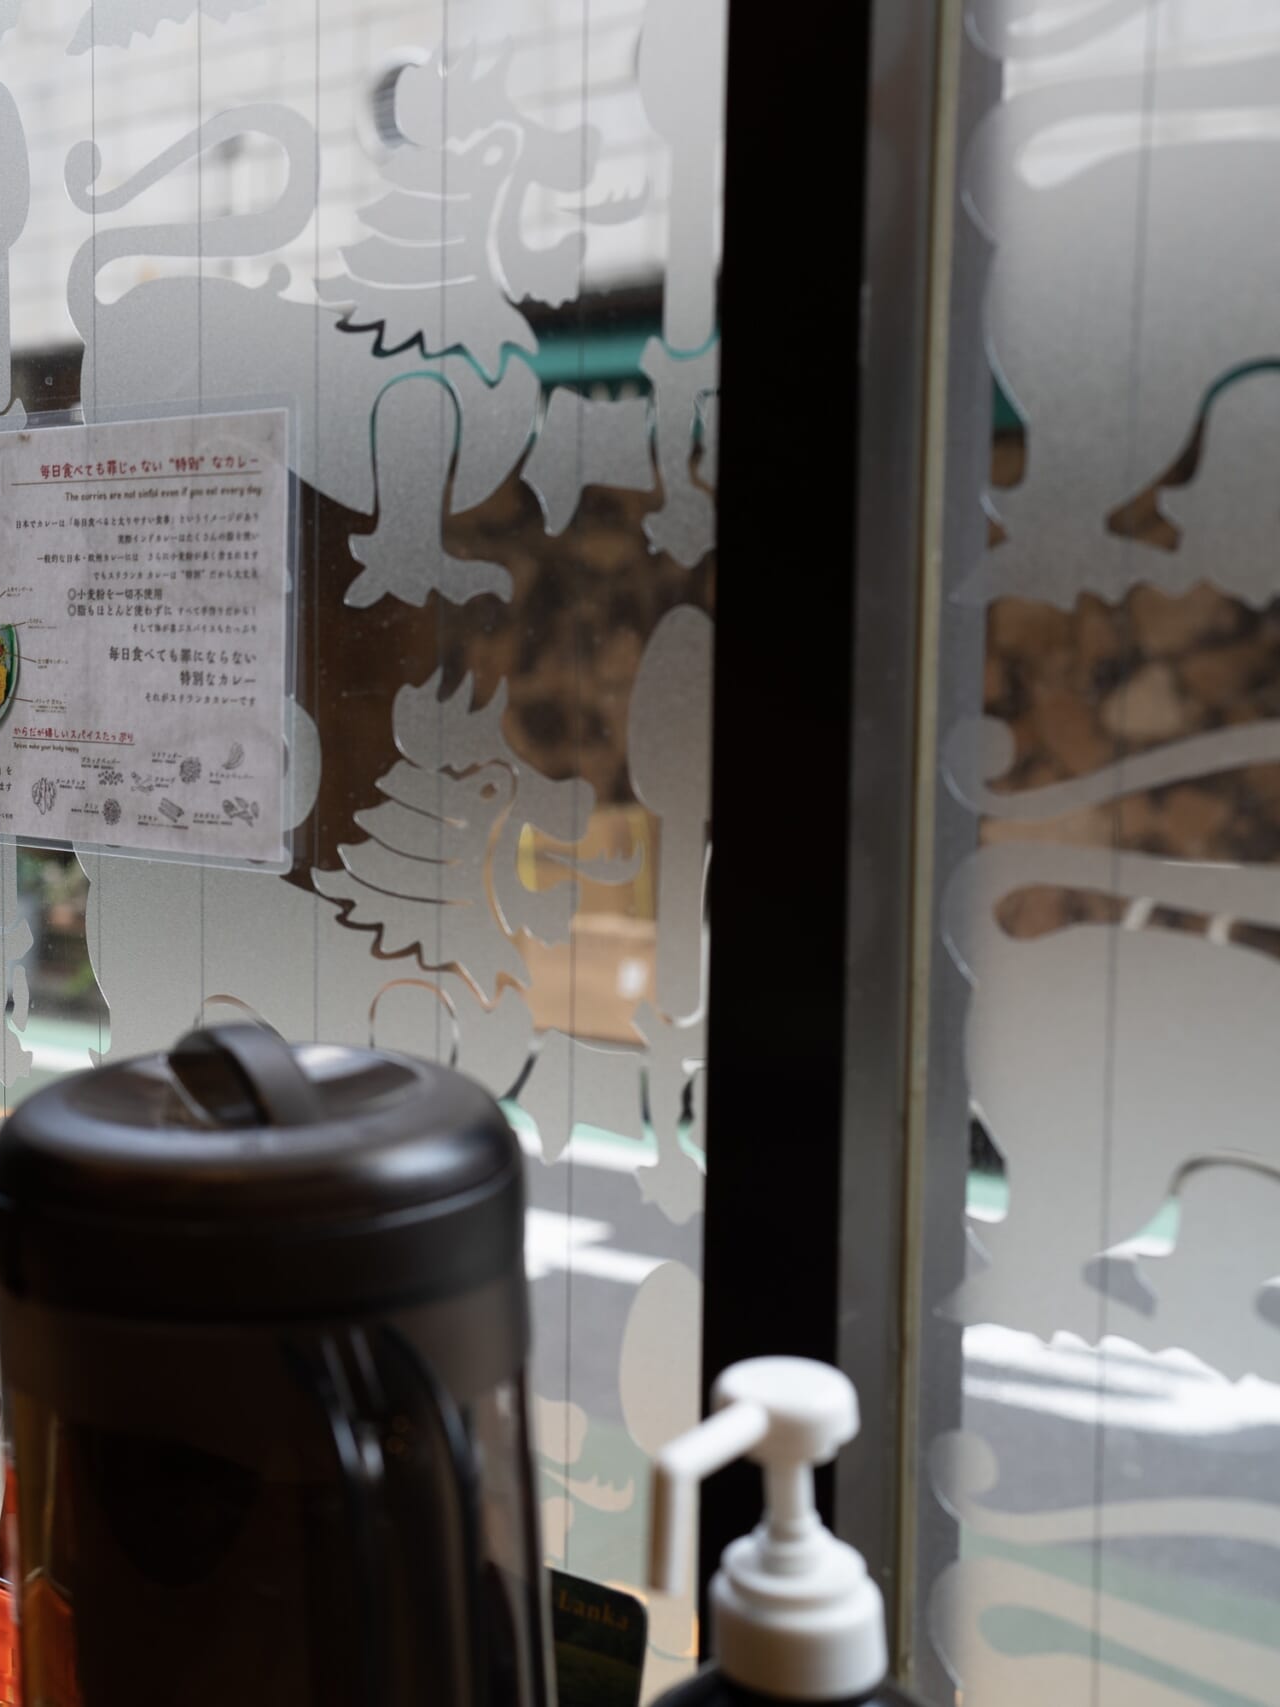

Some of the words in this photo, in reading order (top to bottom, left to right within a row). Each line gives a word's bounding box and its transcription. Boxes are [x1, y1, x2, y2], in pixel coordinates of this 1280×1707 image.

[64, 491, 78, 501] The
[80, 491, 106, 501] curries
[108, 491, 123, 500] are
[124, 489, 136, 499] not
[138, 488, 158, 499] sinful
[160, 488, 179, 498] even
[189, 488, 203, 499] you
[220, 486, 244, 498] every
[109, 646, 257, 665] 毎日食べても罪にならない
[180, 669, 257, 687] 特別なカレー
